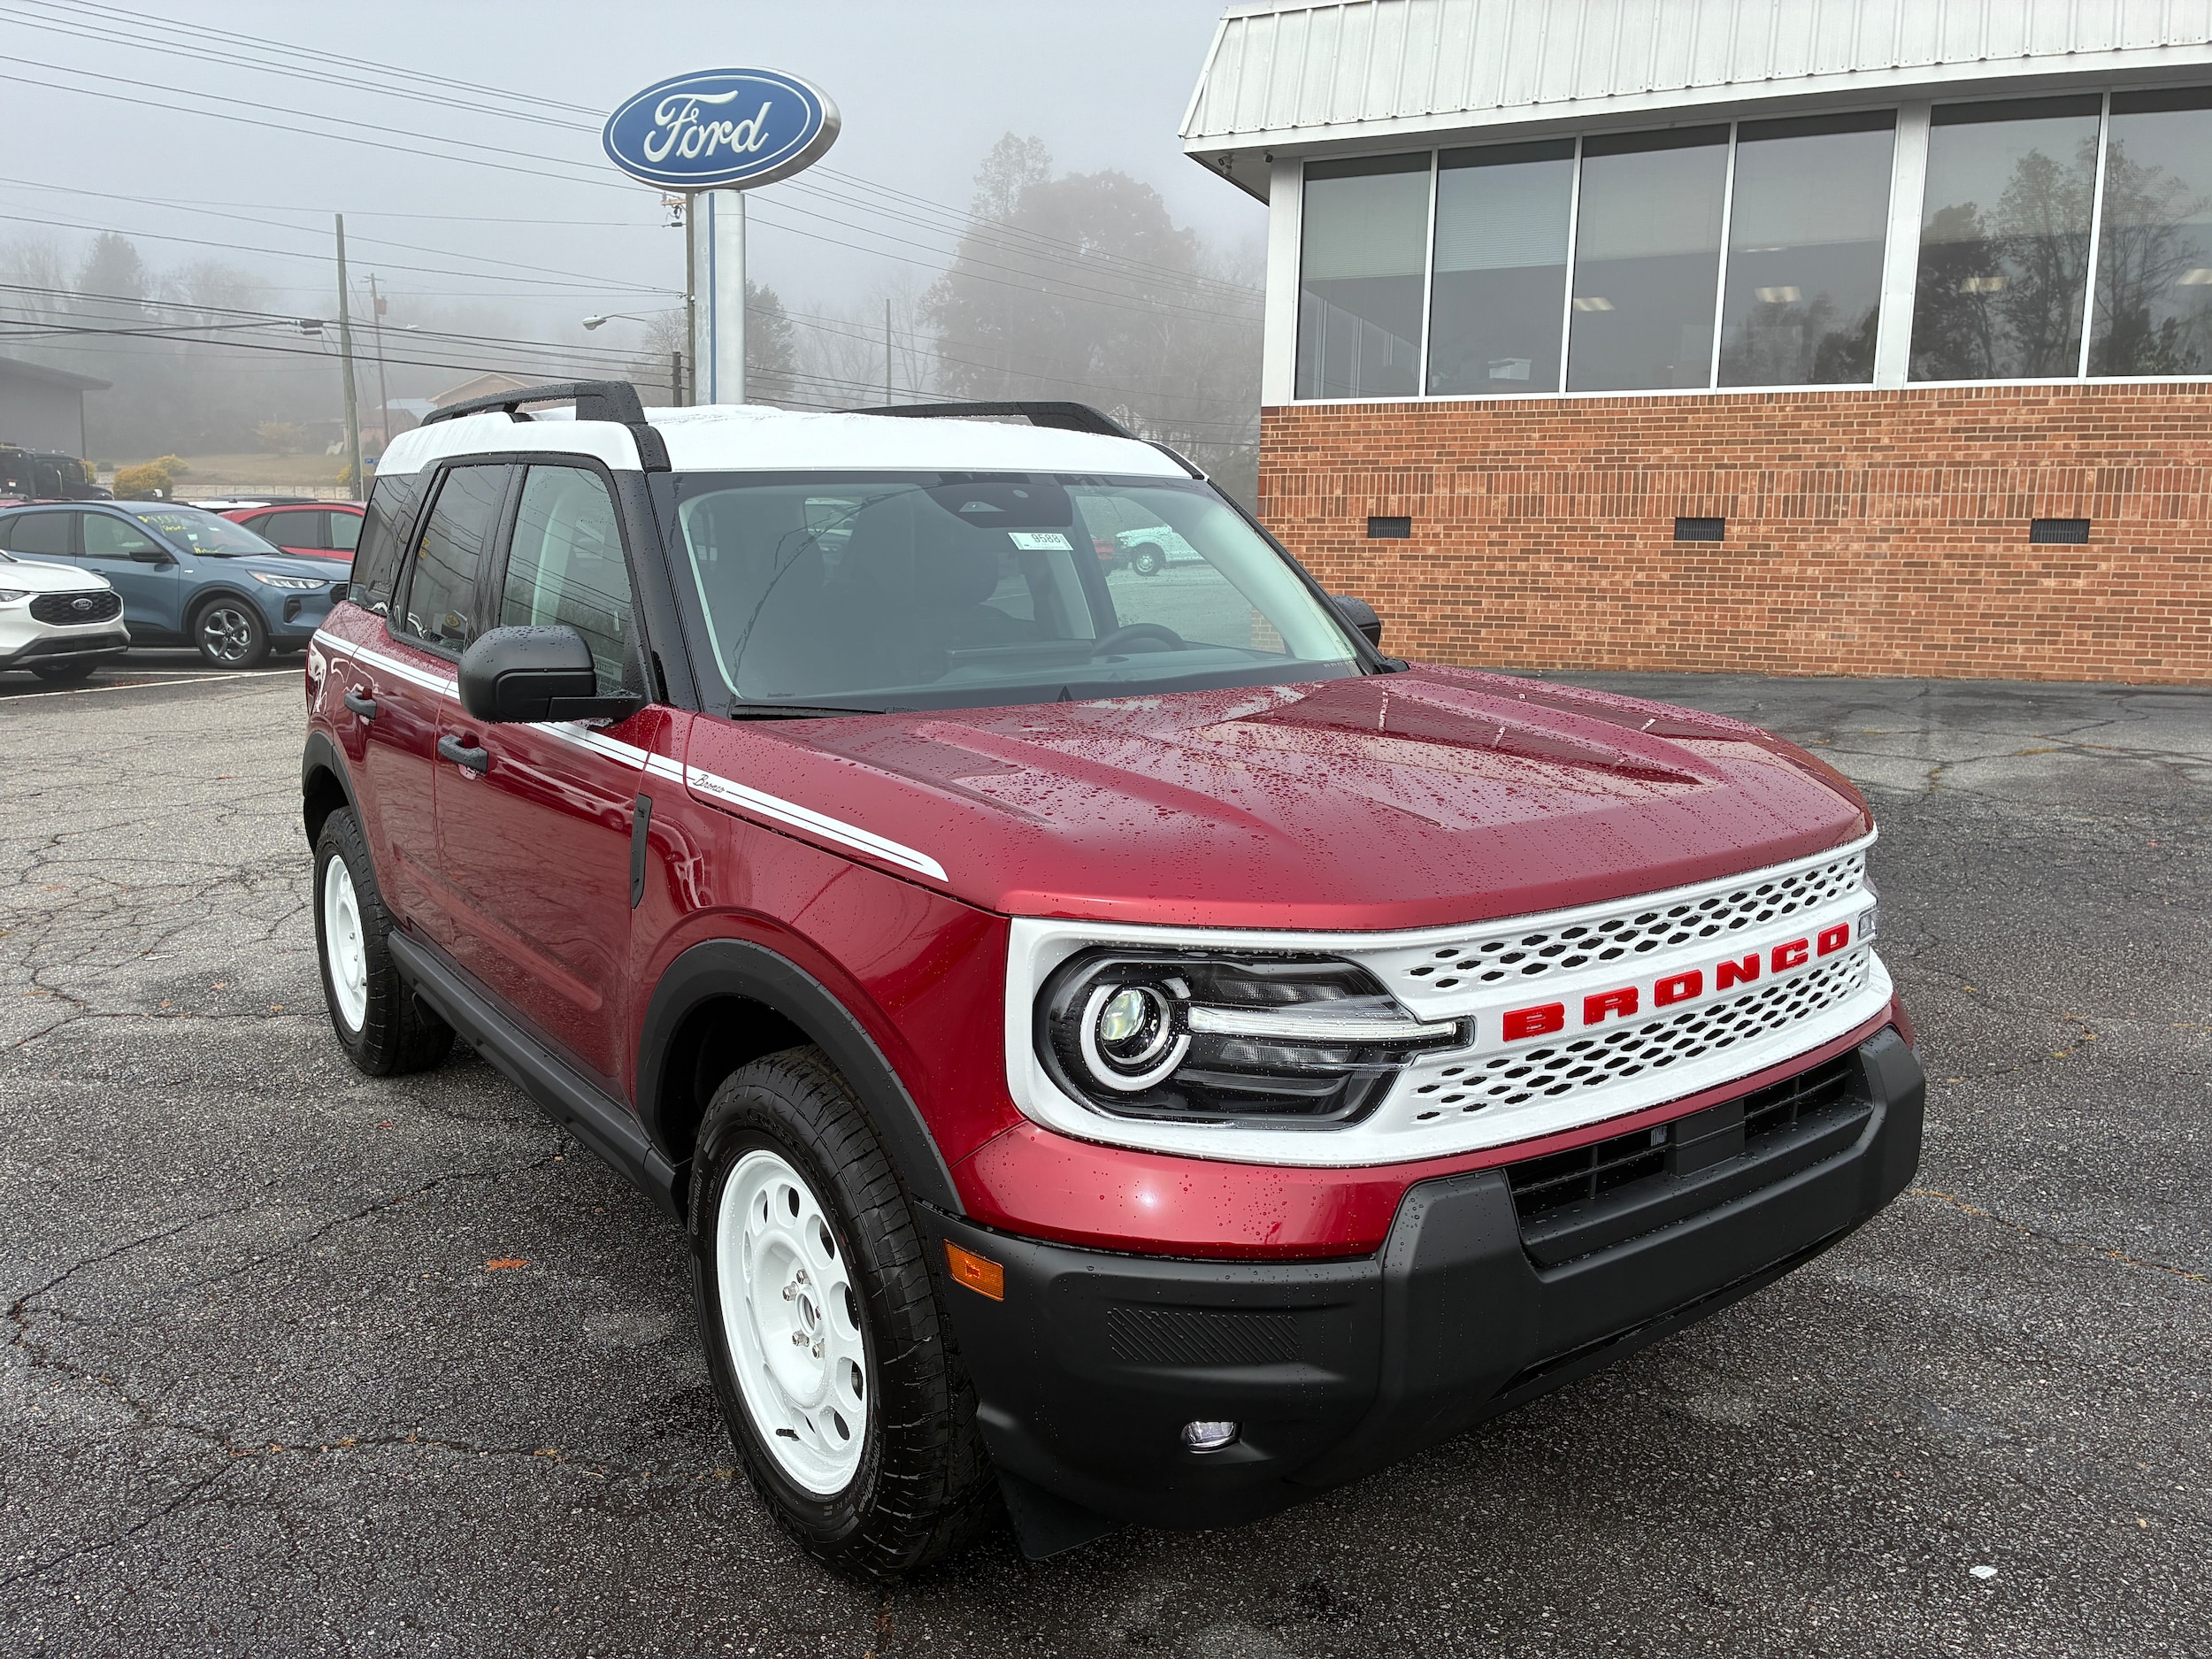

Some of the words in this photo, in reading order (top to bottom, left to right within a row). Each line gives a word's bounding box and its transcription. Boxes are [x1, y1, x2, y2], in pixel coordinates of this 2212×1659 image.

[643, 89, 774, 163] Ford
[1031, 534, 1061, 543] 9588
[693, 773, 726, 794] Bronco
[1502, 922, 1850, 1042] BRONCO
